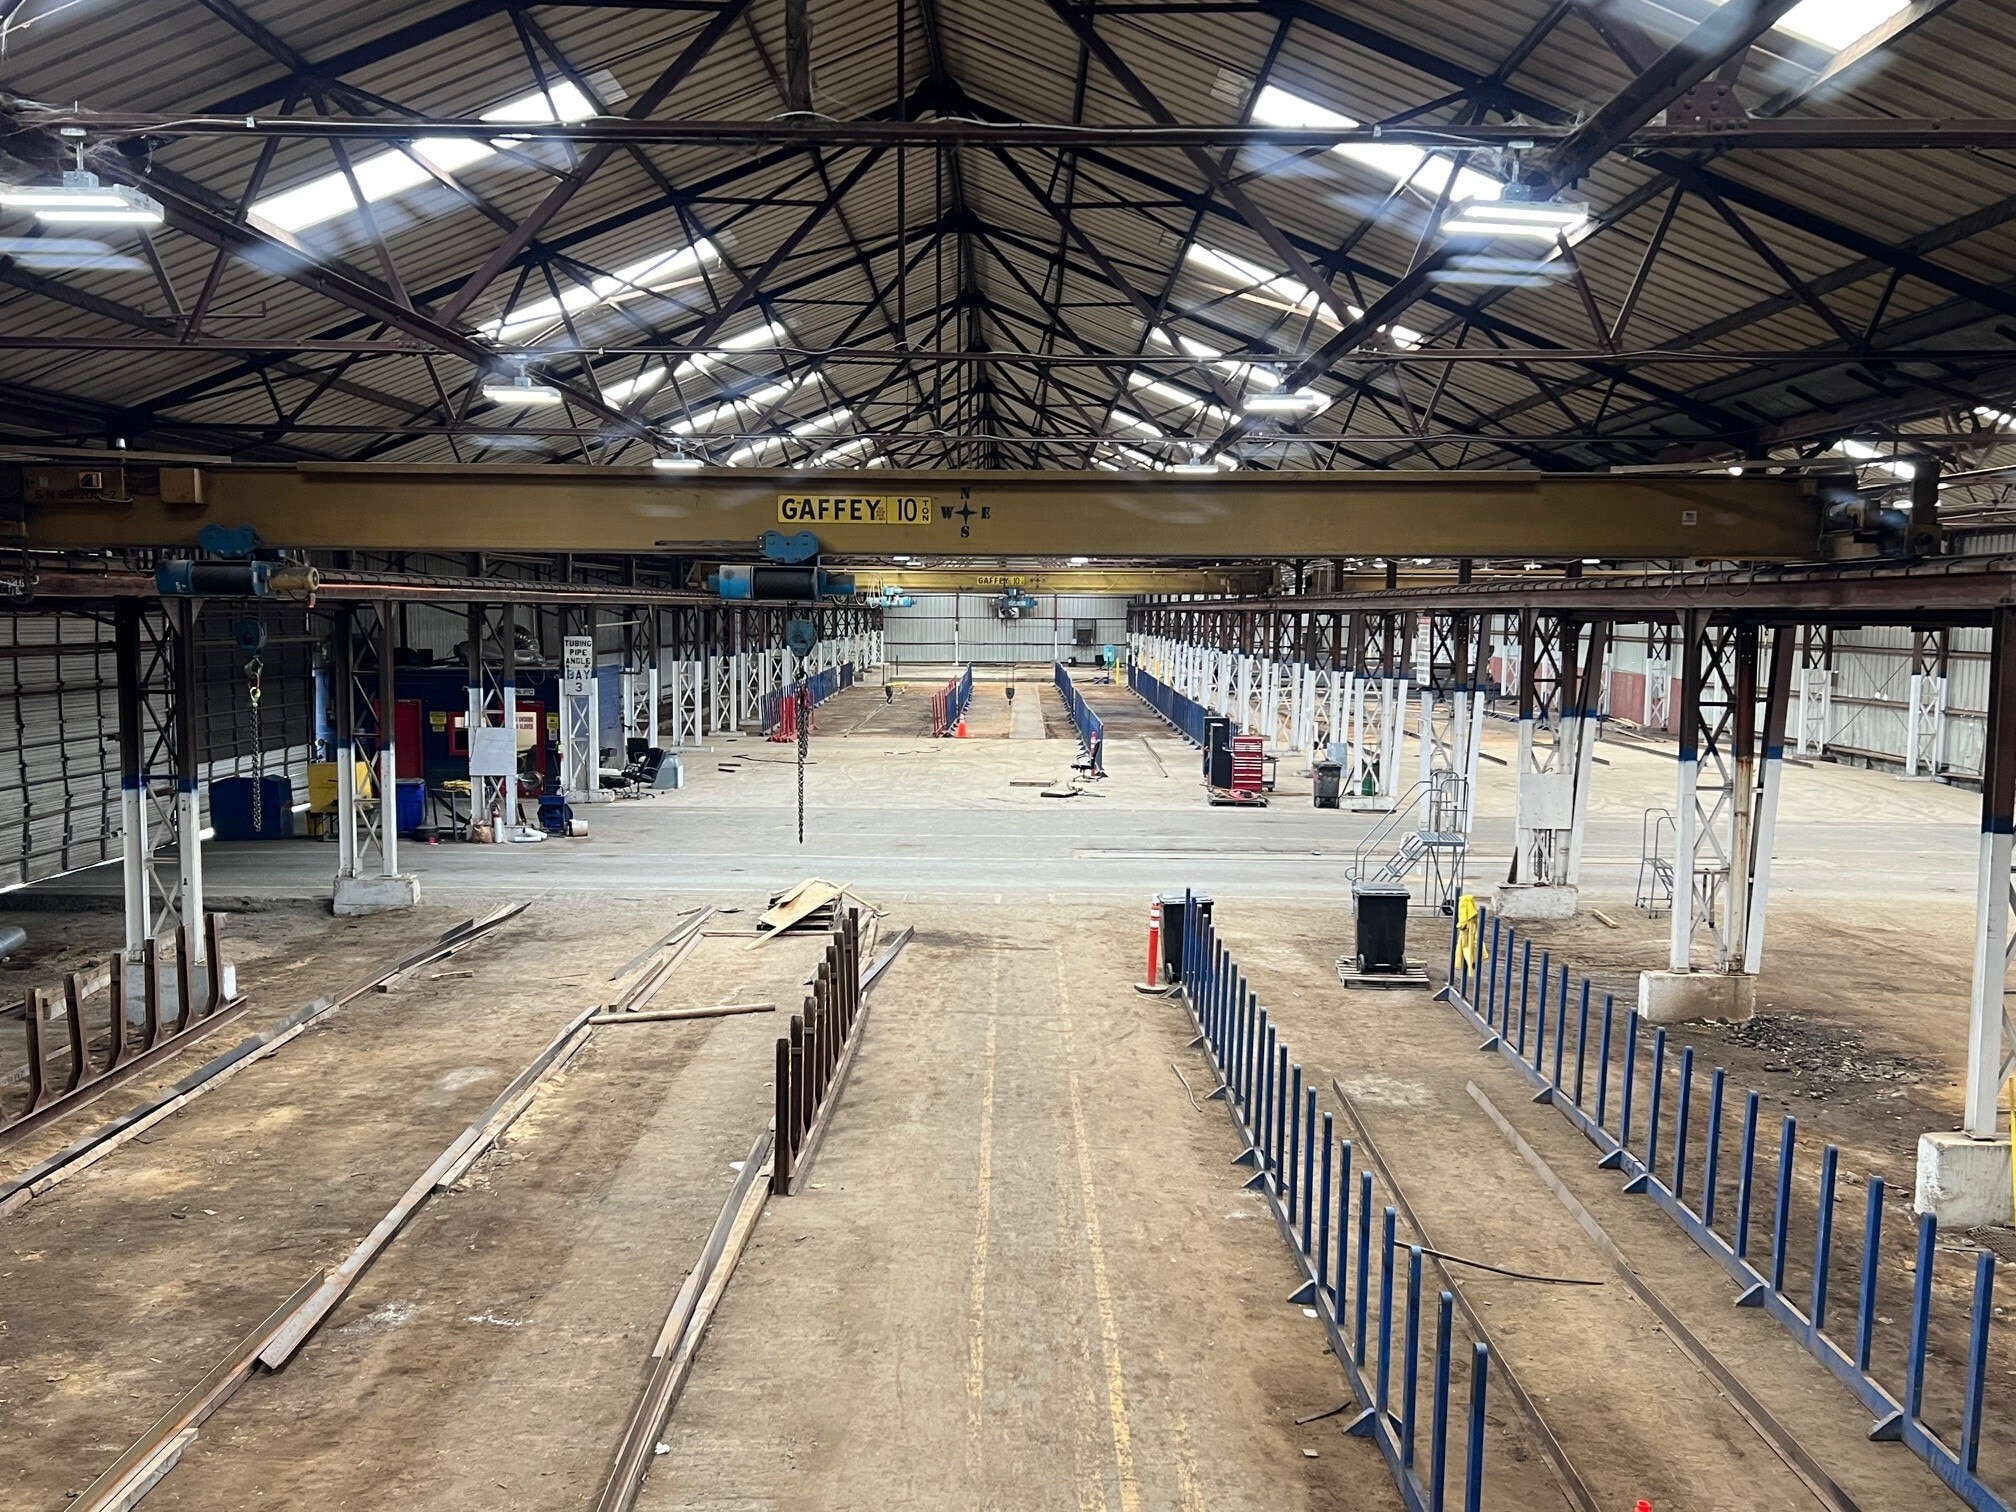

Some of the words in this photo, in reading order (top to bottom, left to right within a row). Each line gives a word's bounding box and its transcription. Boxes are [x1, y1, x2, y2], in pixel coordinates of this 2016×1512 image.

[961, 487, 970, 500] N
[781, 498, 881, 521] GAFFEY
[897, 498, 917, 522] 10
[941, 506, 954, 519] W
[981, 507, 990, 519] E
[961, 526, 969, 538] S
[978, 577, 1009, 585] GAFFEY
[1013, 577, 1020, 585] 10
[564, 639, 592, 647] TUBING
[566, 657, 591, 665] ANGLE
[566, 669, 590, 680] BAY
[575, 682, 583, 692] 3
